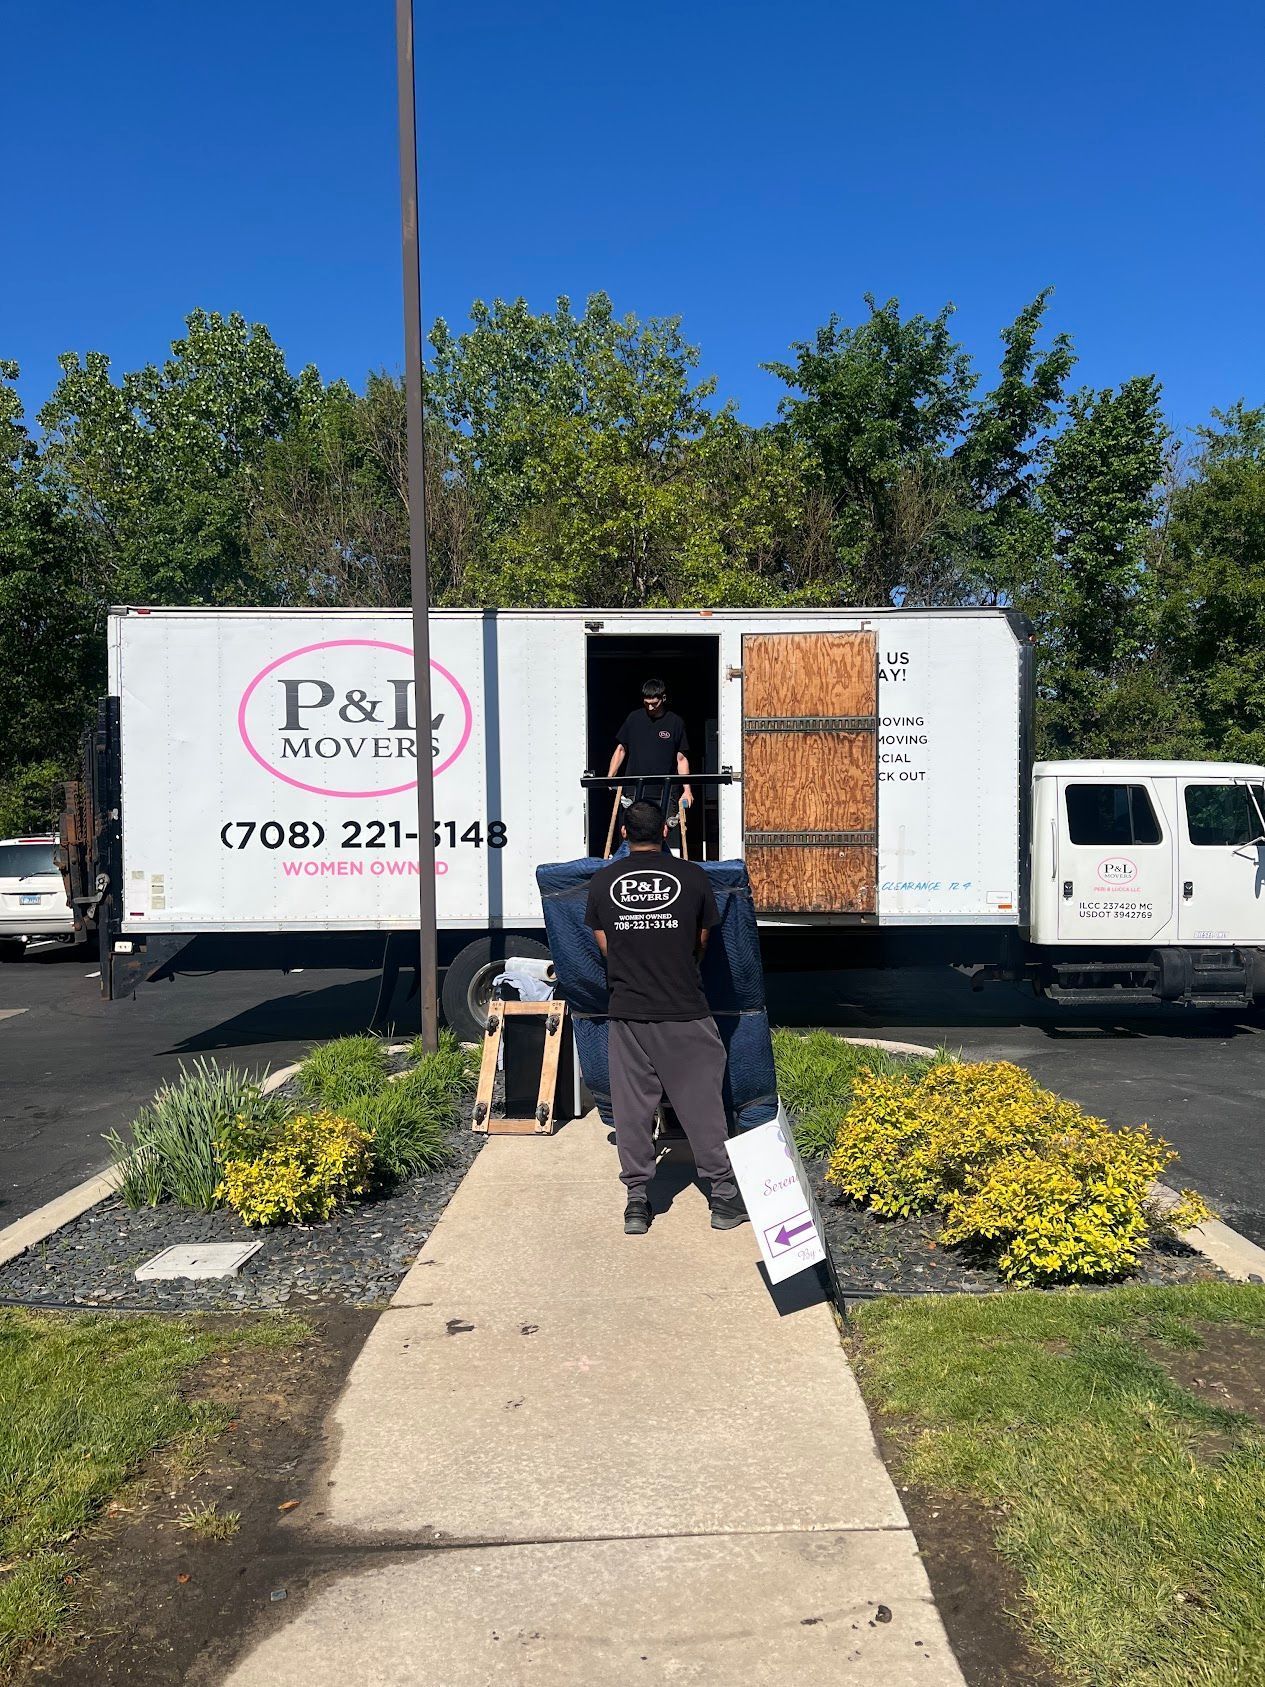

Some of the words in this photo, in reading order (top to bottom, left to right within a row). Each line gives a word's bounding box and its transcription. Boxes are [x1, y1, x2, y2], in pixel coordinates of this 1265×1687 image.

[887, 652, 909, 665] US
[277, 679, 445, 731] P&L
[878, 717, 924, 727] OVING
[280, 737, 440, 759] MOVERS
[899, 771, 926, 781] OUT
[220, 820, 325, 850] (708)
[283, 861, 363, 876] WOMEN
[370, 861, 449, 876] OWND
[1104, 864, 1133, 874] P&L
[619, 878, 671, 896] P&L
[881, 881, 941, 891] CLEARANCE
[620, 893, 670, 903] MOVERS
[1079, 902, 1101, 910] ILCC
[1103, 902, 1137, 910] 237420
[1079, 910, 1111, 918] USDOT
[1113, 911, 1153, 919] 3942769
[613, 919, 679, 931] 708-221-3148
